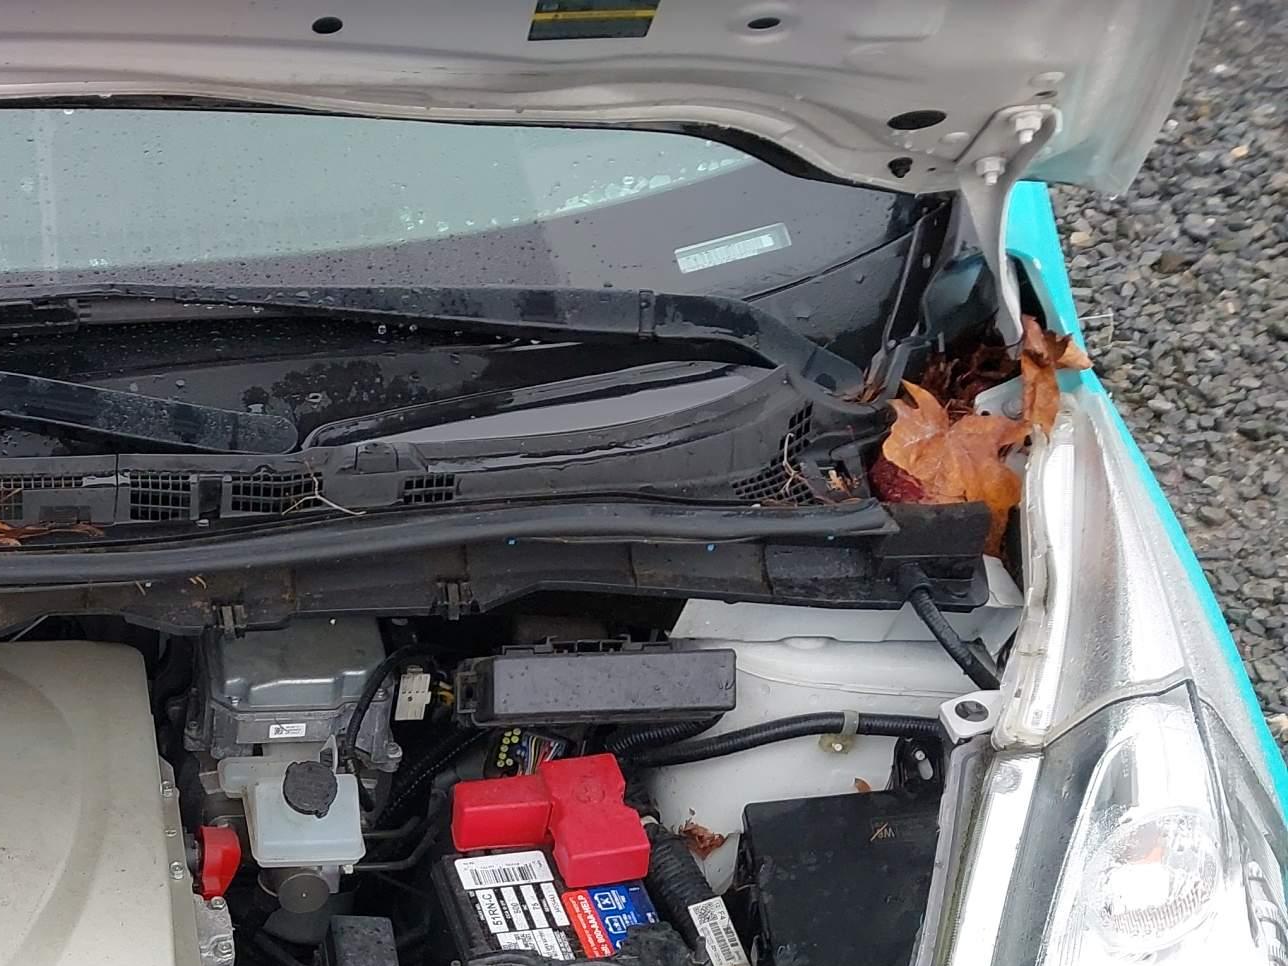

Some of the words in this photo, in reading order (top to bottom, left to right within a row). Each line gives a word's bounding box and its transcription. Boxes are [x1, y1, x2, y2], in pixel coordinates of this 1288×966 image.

[481, 892, 502, 926] 51RN-C
[511, 901, 521, 914] 500
[577, 894, 605, 943] 800-AAA-HELP
